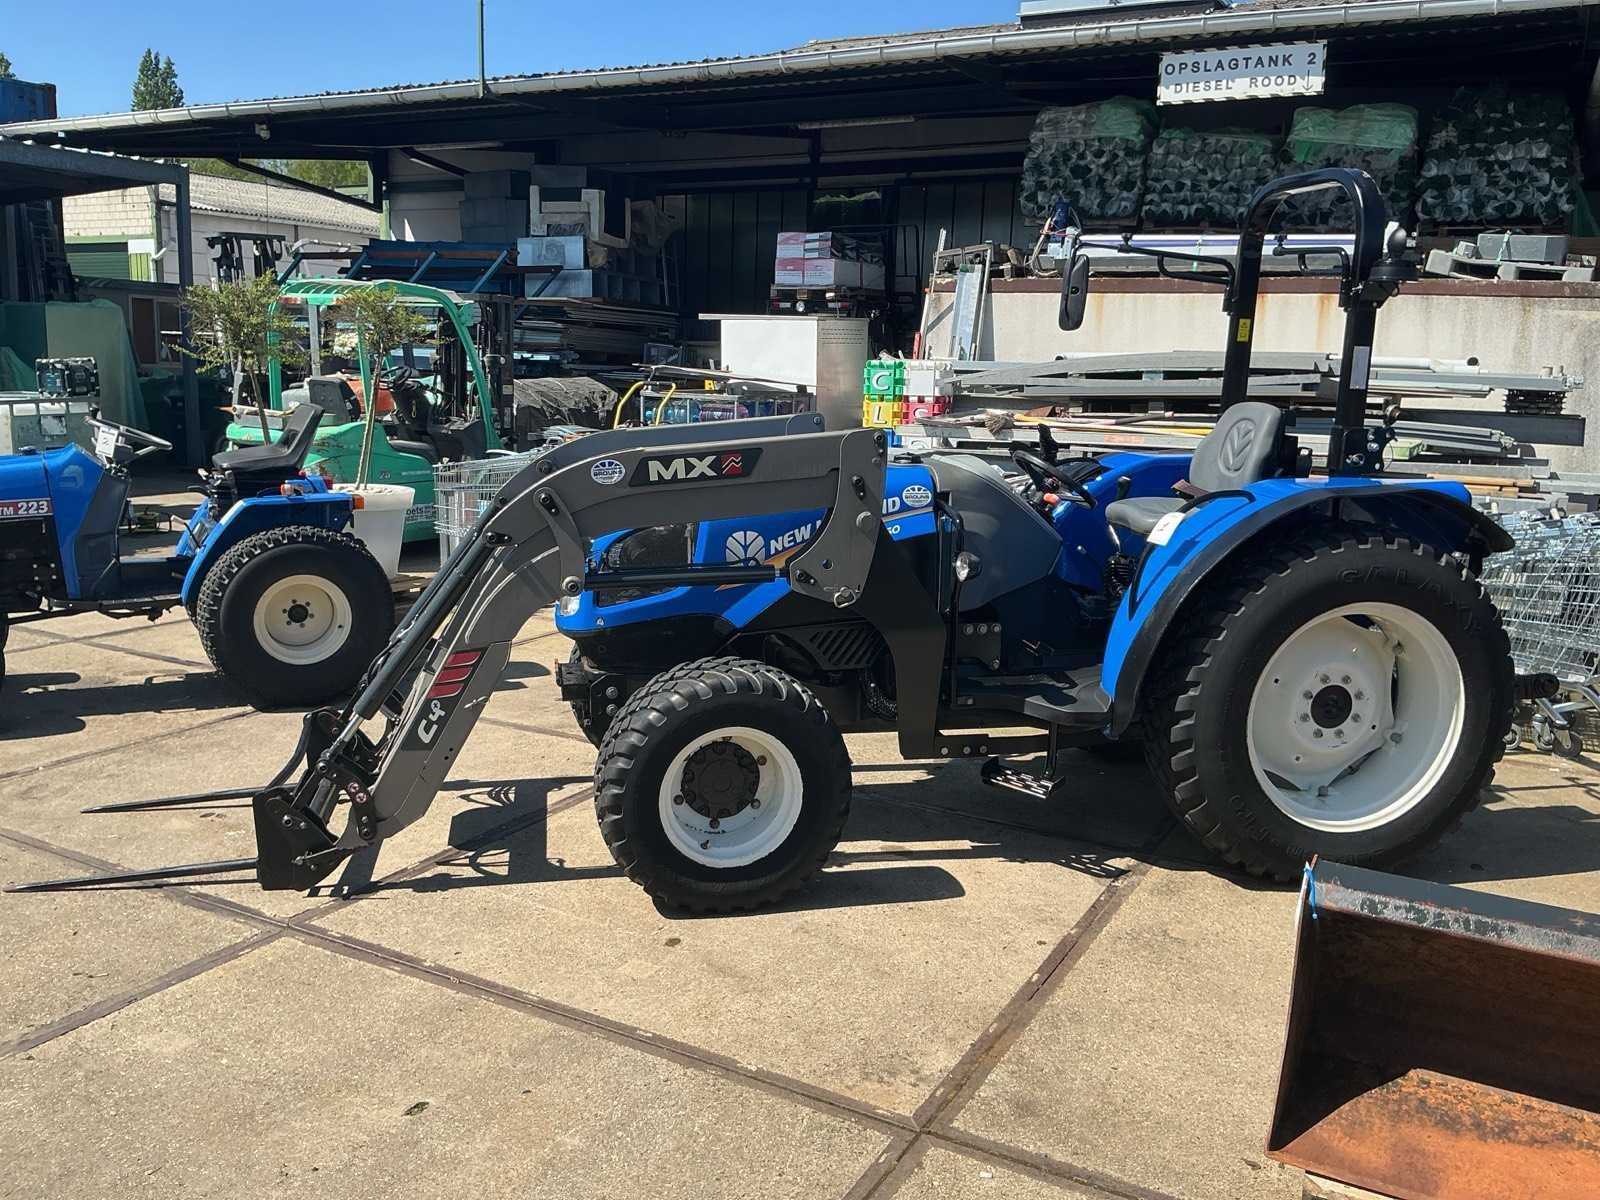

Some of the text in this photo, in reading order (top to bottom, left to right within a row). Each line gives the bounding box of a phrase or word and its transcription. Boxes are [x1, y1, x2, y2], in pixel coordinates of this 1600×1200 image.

[1164, 52, 1317, 76] OPSLAGTANK 2
[1173, 75, 1298, 94] DIESEL ROOD
[872, 371, 892, 391] C
[873, 404, 887, 424] L
[648, 455, 718, 481] MX
[17, 500, 49, 515] 223
[769, 523, 812, 555] NEW
